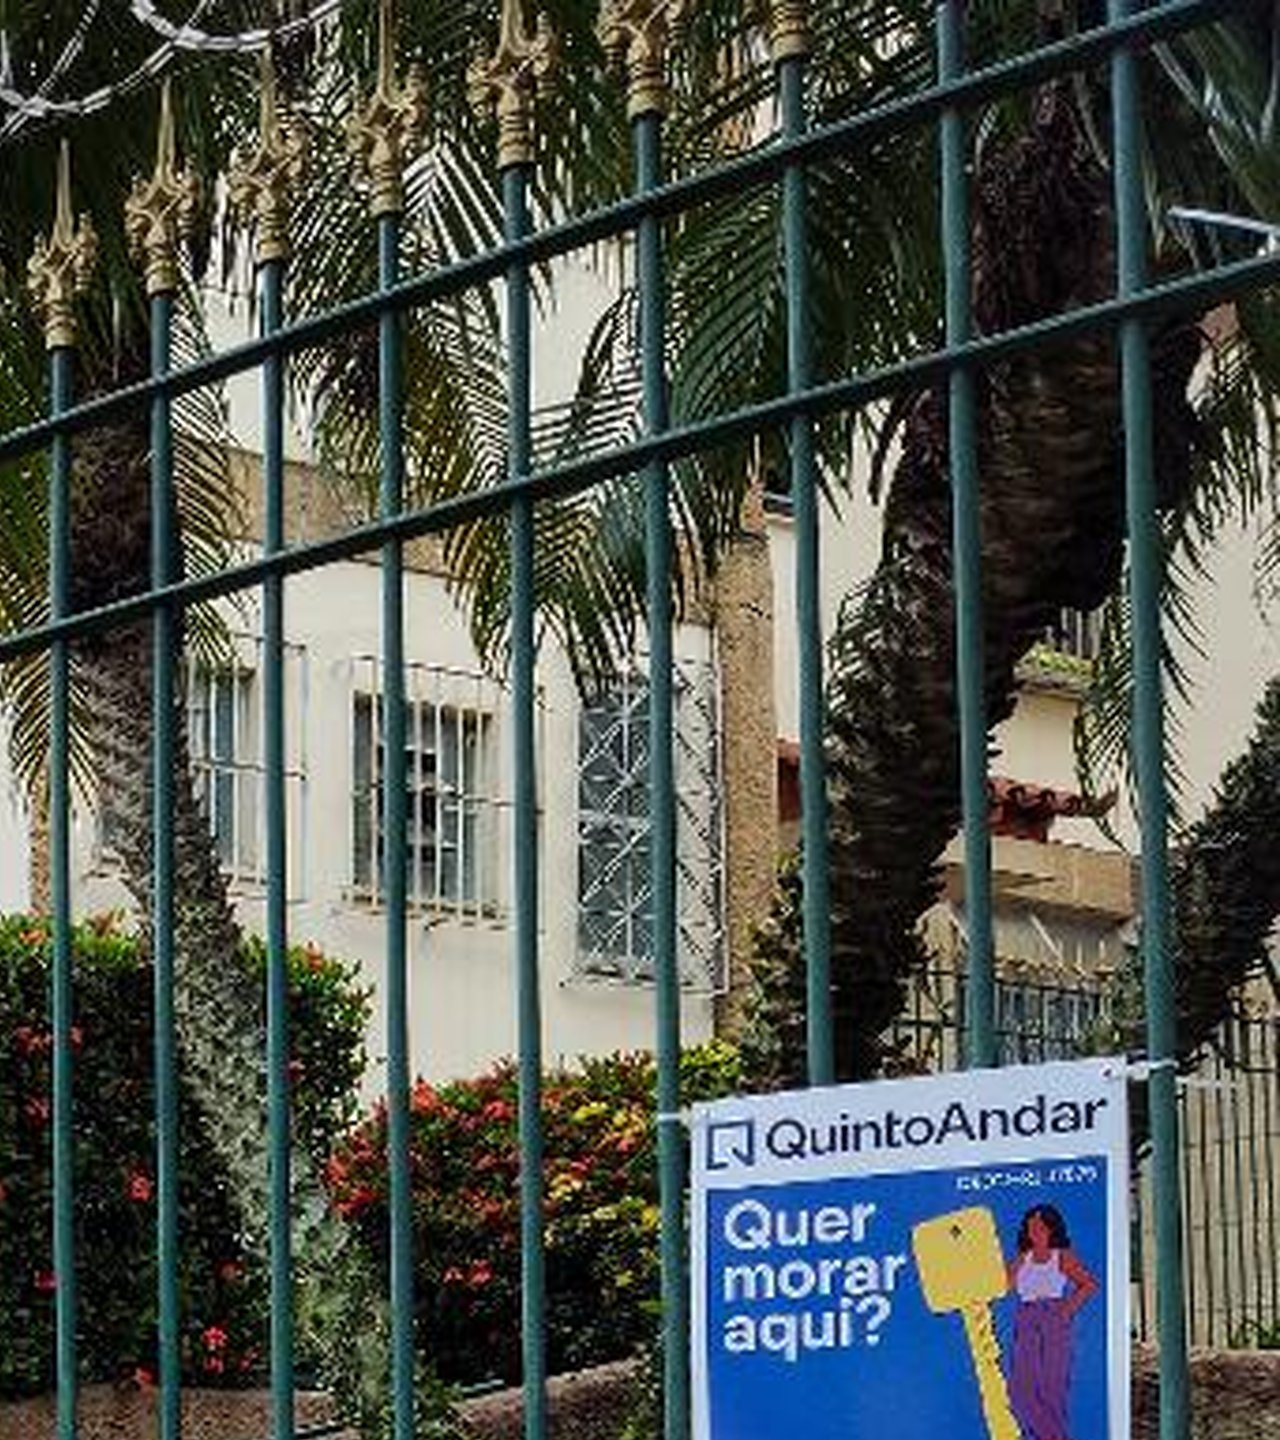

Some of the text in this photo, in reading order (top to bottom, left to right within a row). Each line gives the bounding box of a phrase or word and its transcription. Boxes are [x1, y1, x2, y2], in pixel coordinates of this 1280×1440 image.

[765, 1093, 1108, 1162] QuintoAndar
[722, 1199, 876, 1250] Quer
[723, 1251, 906, 1302] morar
[723, 1296, 893, 1361] aqui?
